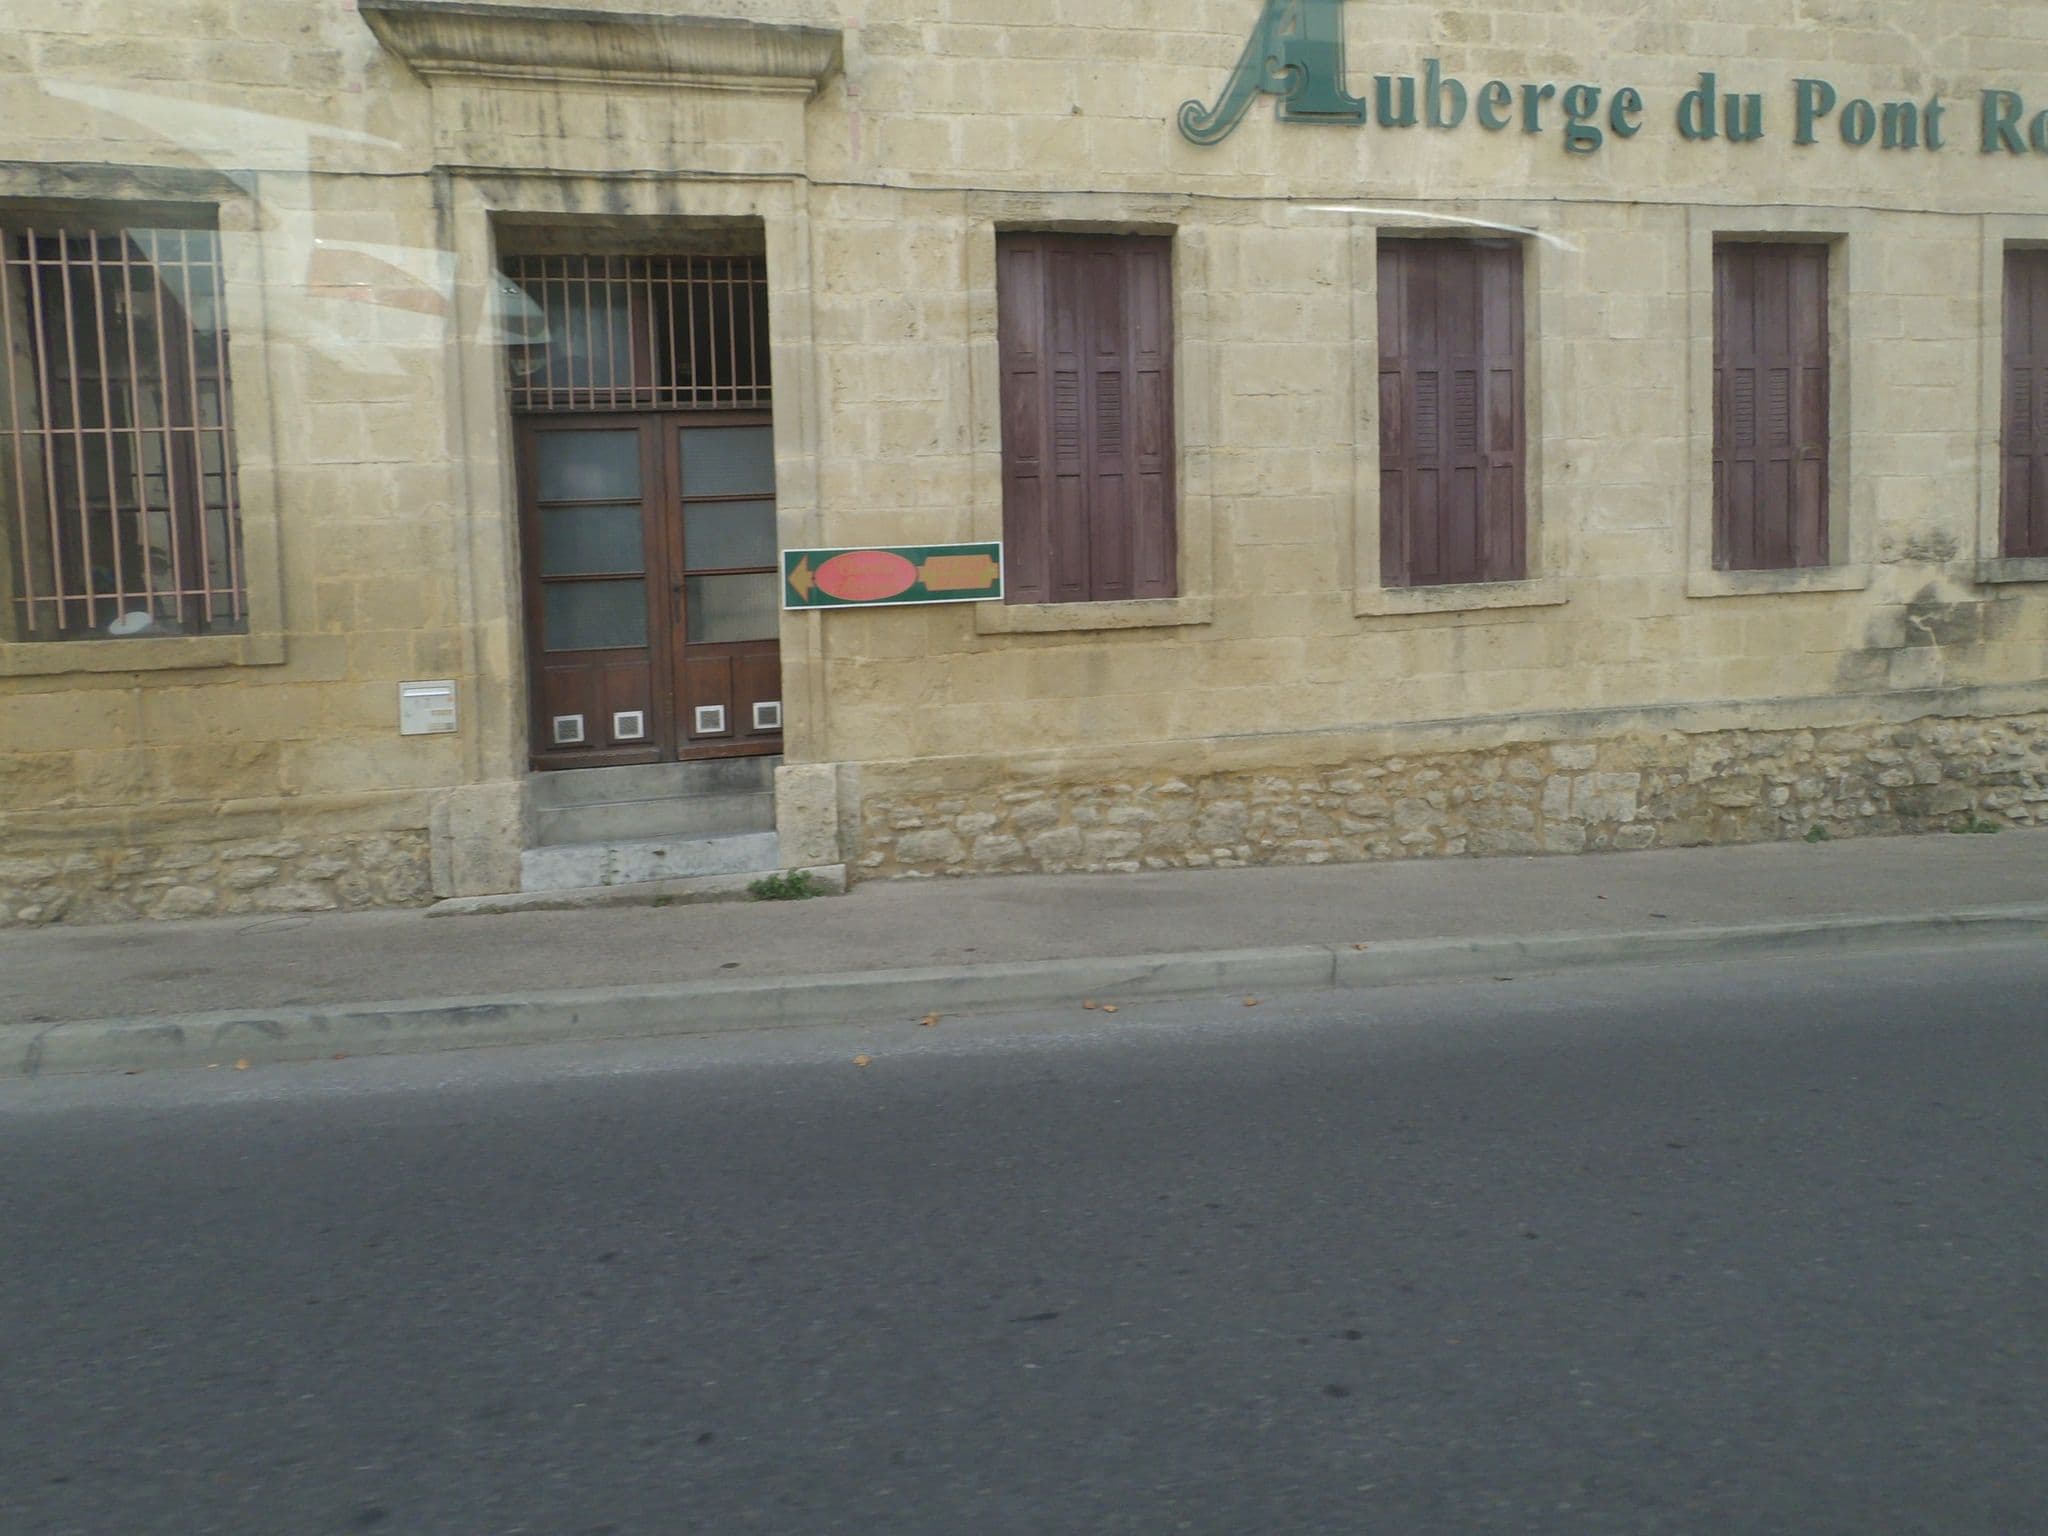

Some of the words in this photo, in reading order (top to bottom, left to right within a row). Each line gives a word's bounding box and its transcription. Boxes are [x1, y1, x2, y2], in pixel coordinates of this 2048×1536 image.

[1179, 0, 1643, 153] Auberge
[1676, 72, 1765, 140] du
[1792, 77, 1945, 151] Pont
